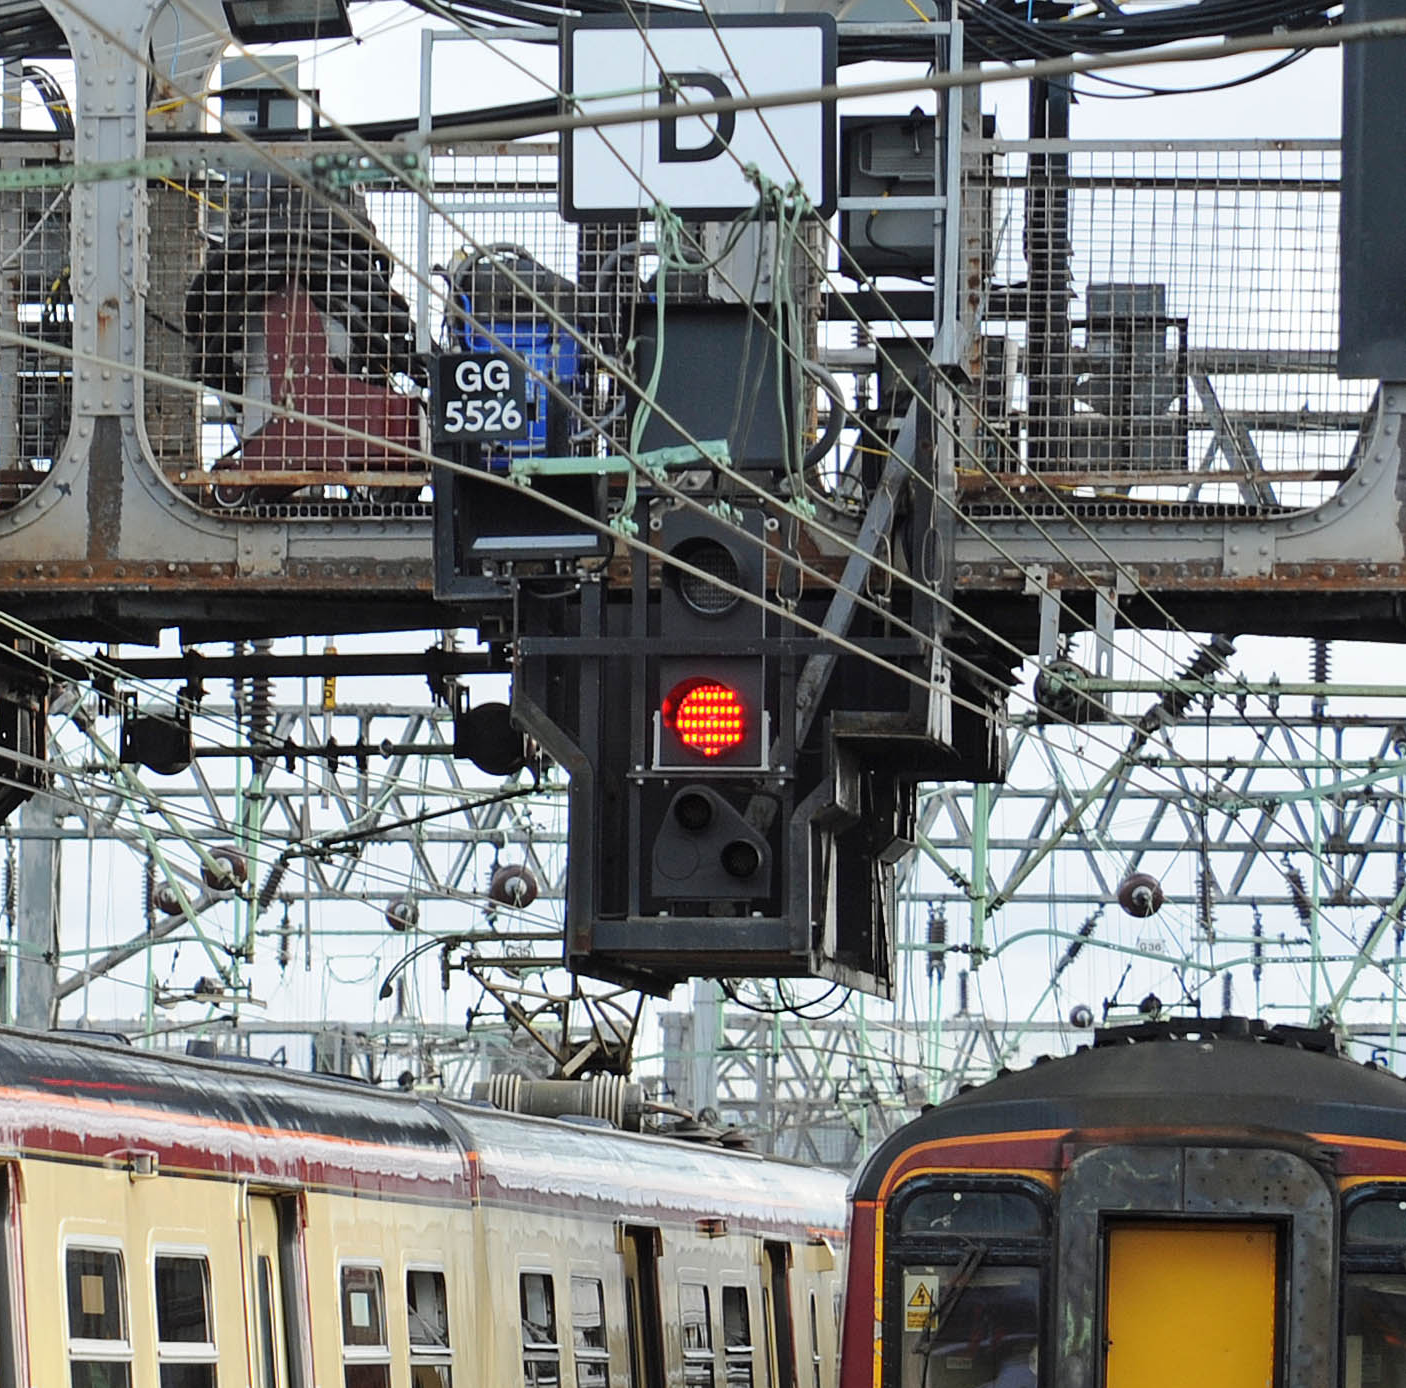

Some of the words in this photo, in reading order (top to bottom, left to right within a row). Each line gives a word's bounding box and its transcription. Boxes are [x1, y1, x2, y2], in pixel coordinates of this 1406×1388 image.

[659, 73, 736, 163] D
[455, 360, 510, 392] GG
[444, 399, 523, 432] 5526
